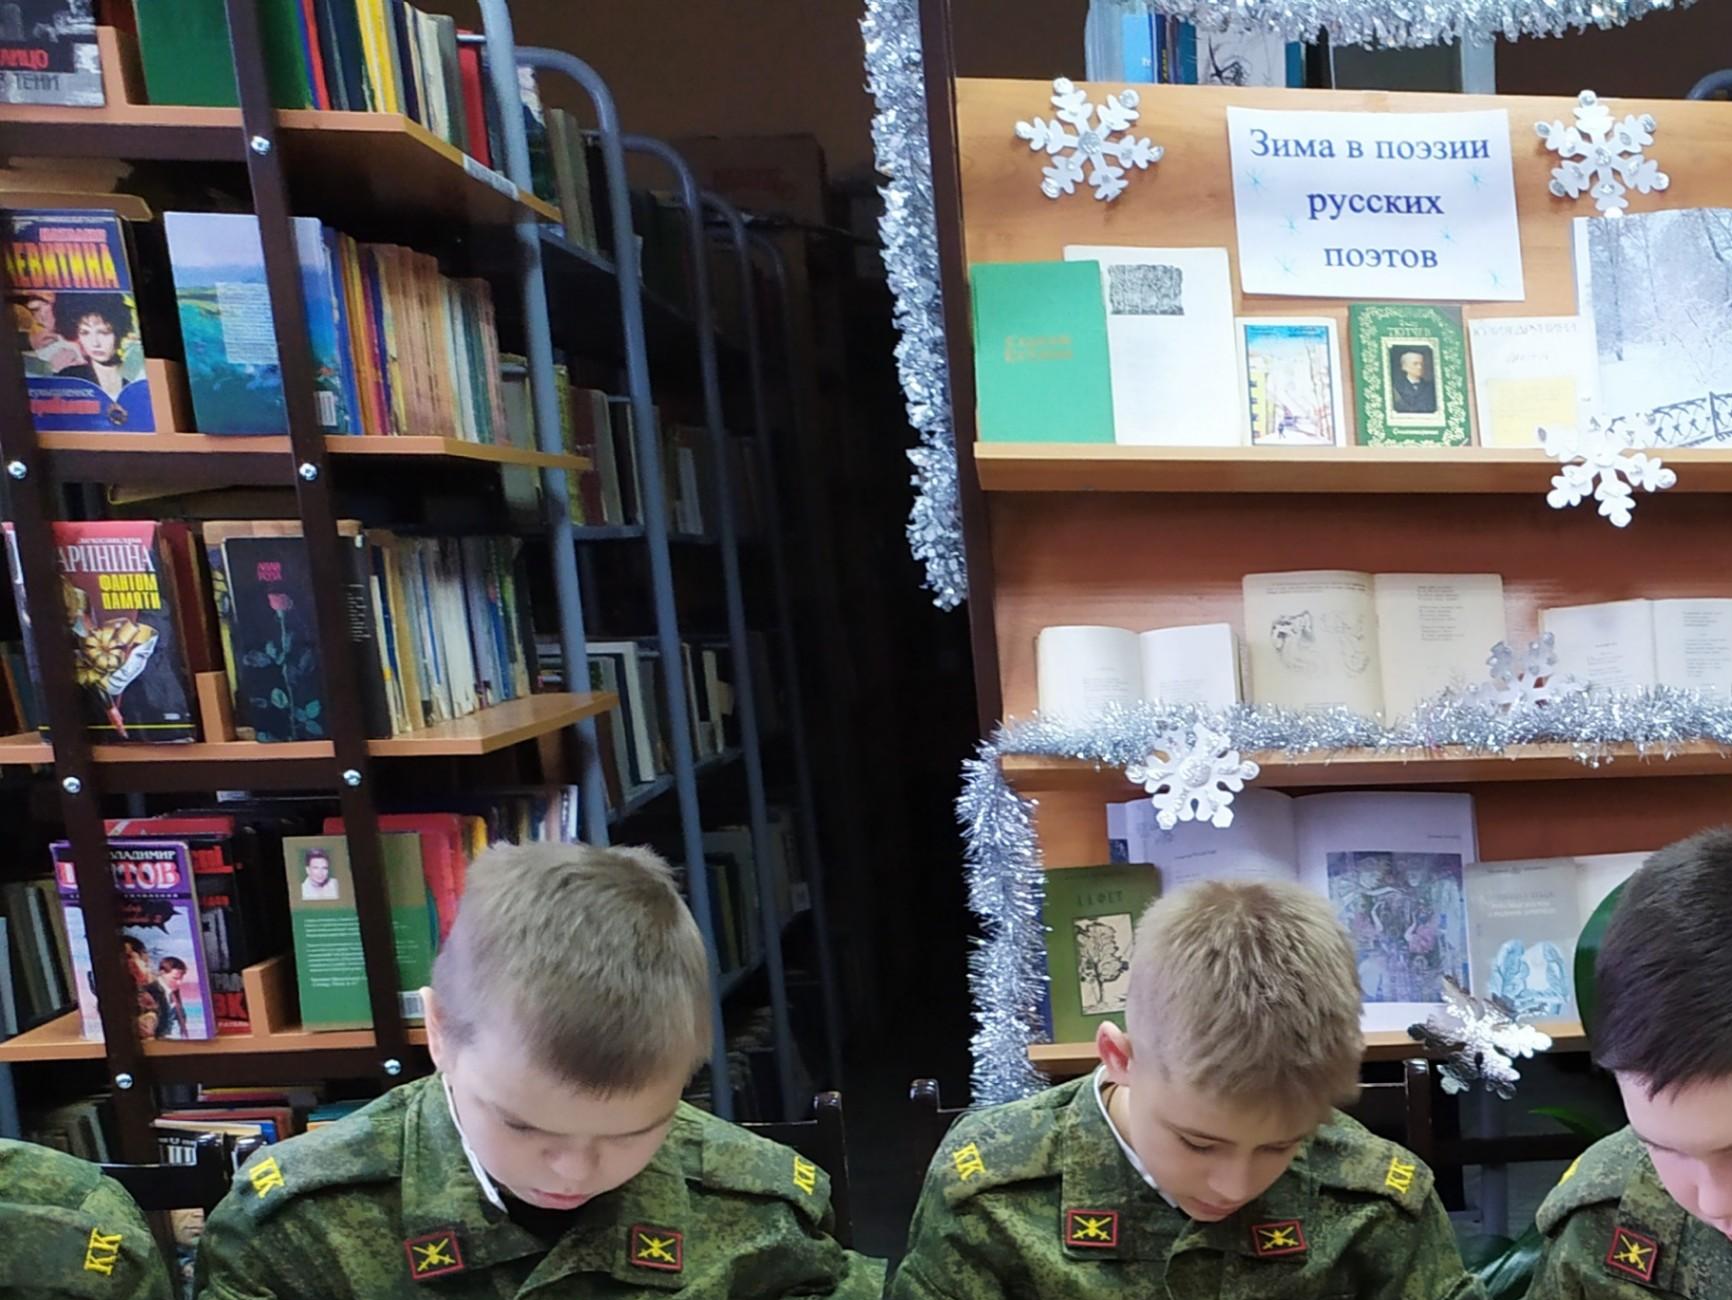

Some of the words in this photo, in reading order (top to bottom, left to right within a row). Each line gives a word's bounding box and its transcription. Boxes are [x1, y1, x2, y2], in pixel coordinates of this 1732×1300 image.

[1250, 128, 1335, 158] Зима
[1347, 139, 1364, 158] в
[1376, 139, 1490, 159] поэзии
[1307, 192, 1444, 220] русских
[1324, 248, 1438, 268] поэтов
[58, 544, 156, 572] АРИНИНА
[98, 574, 159, 591] ФАНТОМ
[101, 591, 162, 610] ПАМЯТИ
[793, 1156, 816, 1196] КК
[953, 1142, 986, 1181] КК
[1385, 1157, 1416, 1194] КК
[84, 1228, 123, 1276] КК
